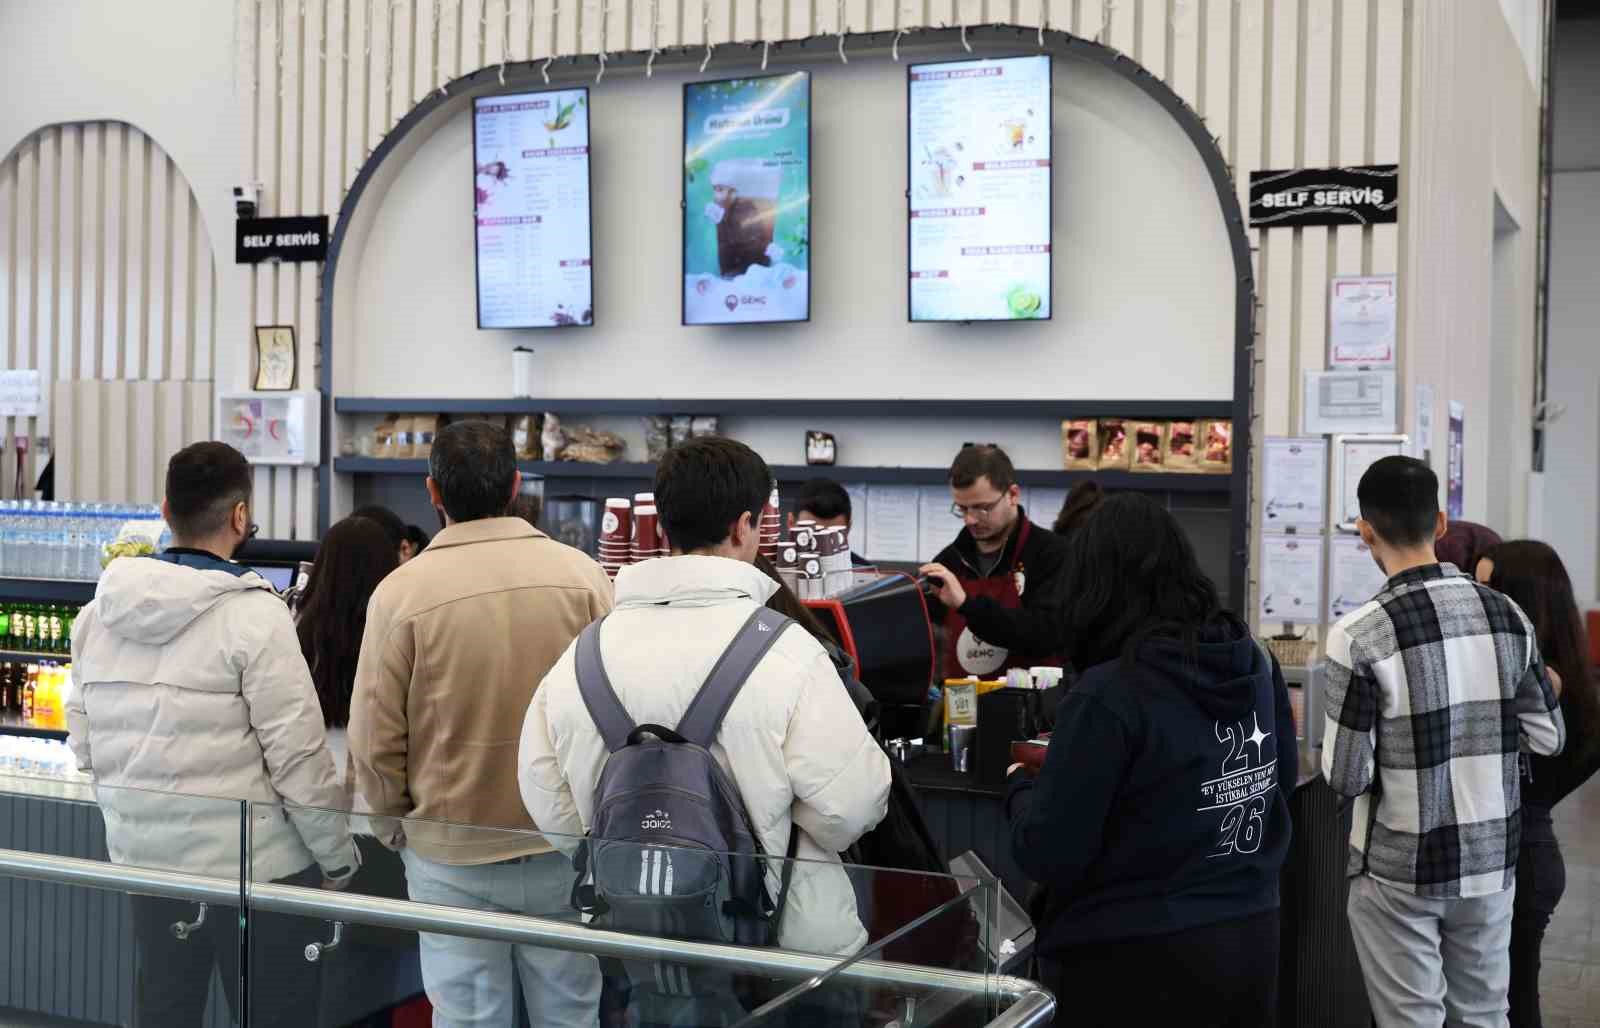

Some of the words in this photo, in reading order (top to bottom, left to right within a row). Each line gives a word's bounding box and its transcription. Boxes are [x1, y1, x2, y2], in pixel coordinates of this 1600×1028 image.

[1261, 191, 1309, 208] SELF
[1313, 186, 1385, 206] SERVİS
[243, 235, 273, 248] SELF
[275, 230, 320, 247] SERVİS
[1218, 774, 1253, 792] YÜKSELEN
[1216, 787, 1248, 804] İSTİKBAL
